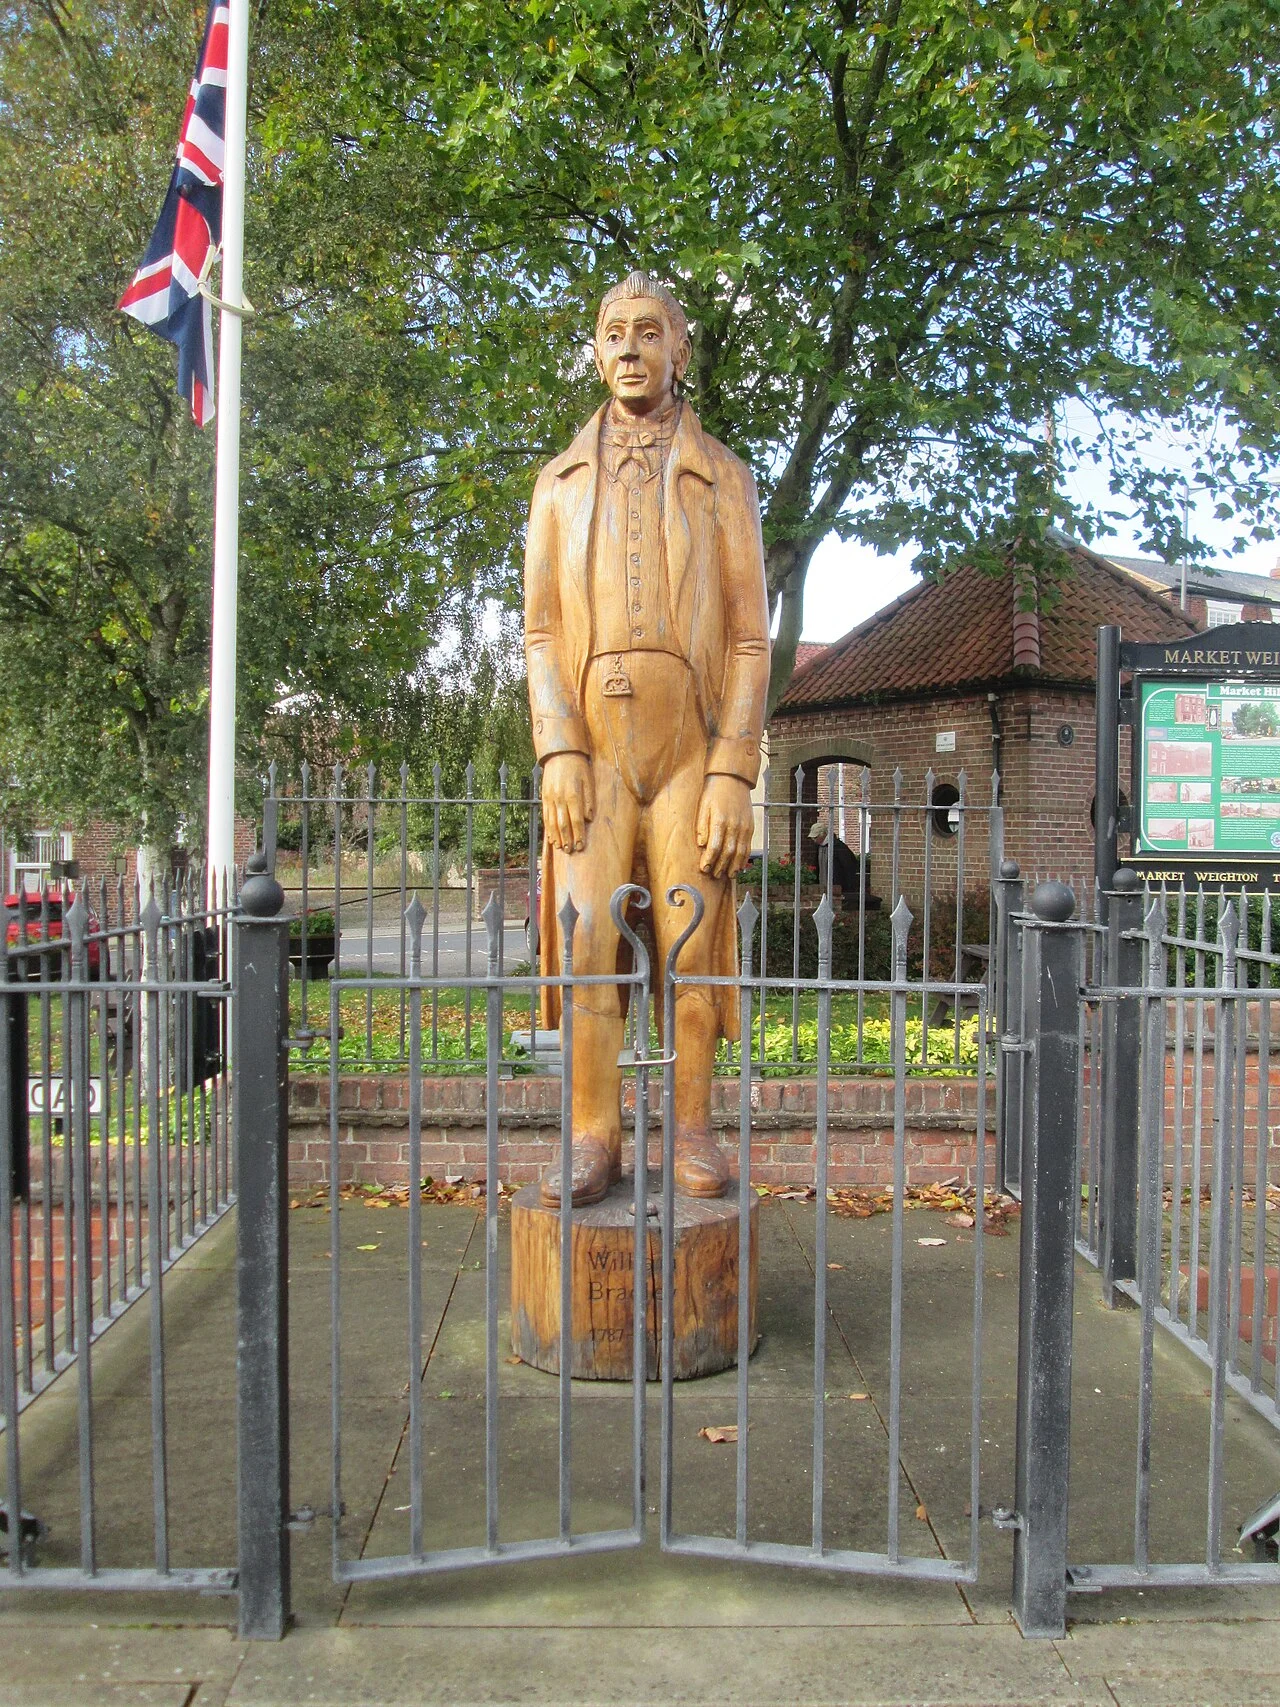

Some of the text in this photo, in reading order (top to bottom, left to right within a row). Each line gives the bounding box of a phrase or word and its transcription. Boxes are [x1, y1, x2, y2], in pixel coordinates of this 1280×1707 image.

[1164, 650, 1242, 665] MARKET
[1220, 686, 1262, 696] Market
[1136, 871, 1185, 881] MARKET
[1194, 872, 1259, 882] WEIGHTON
